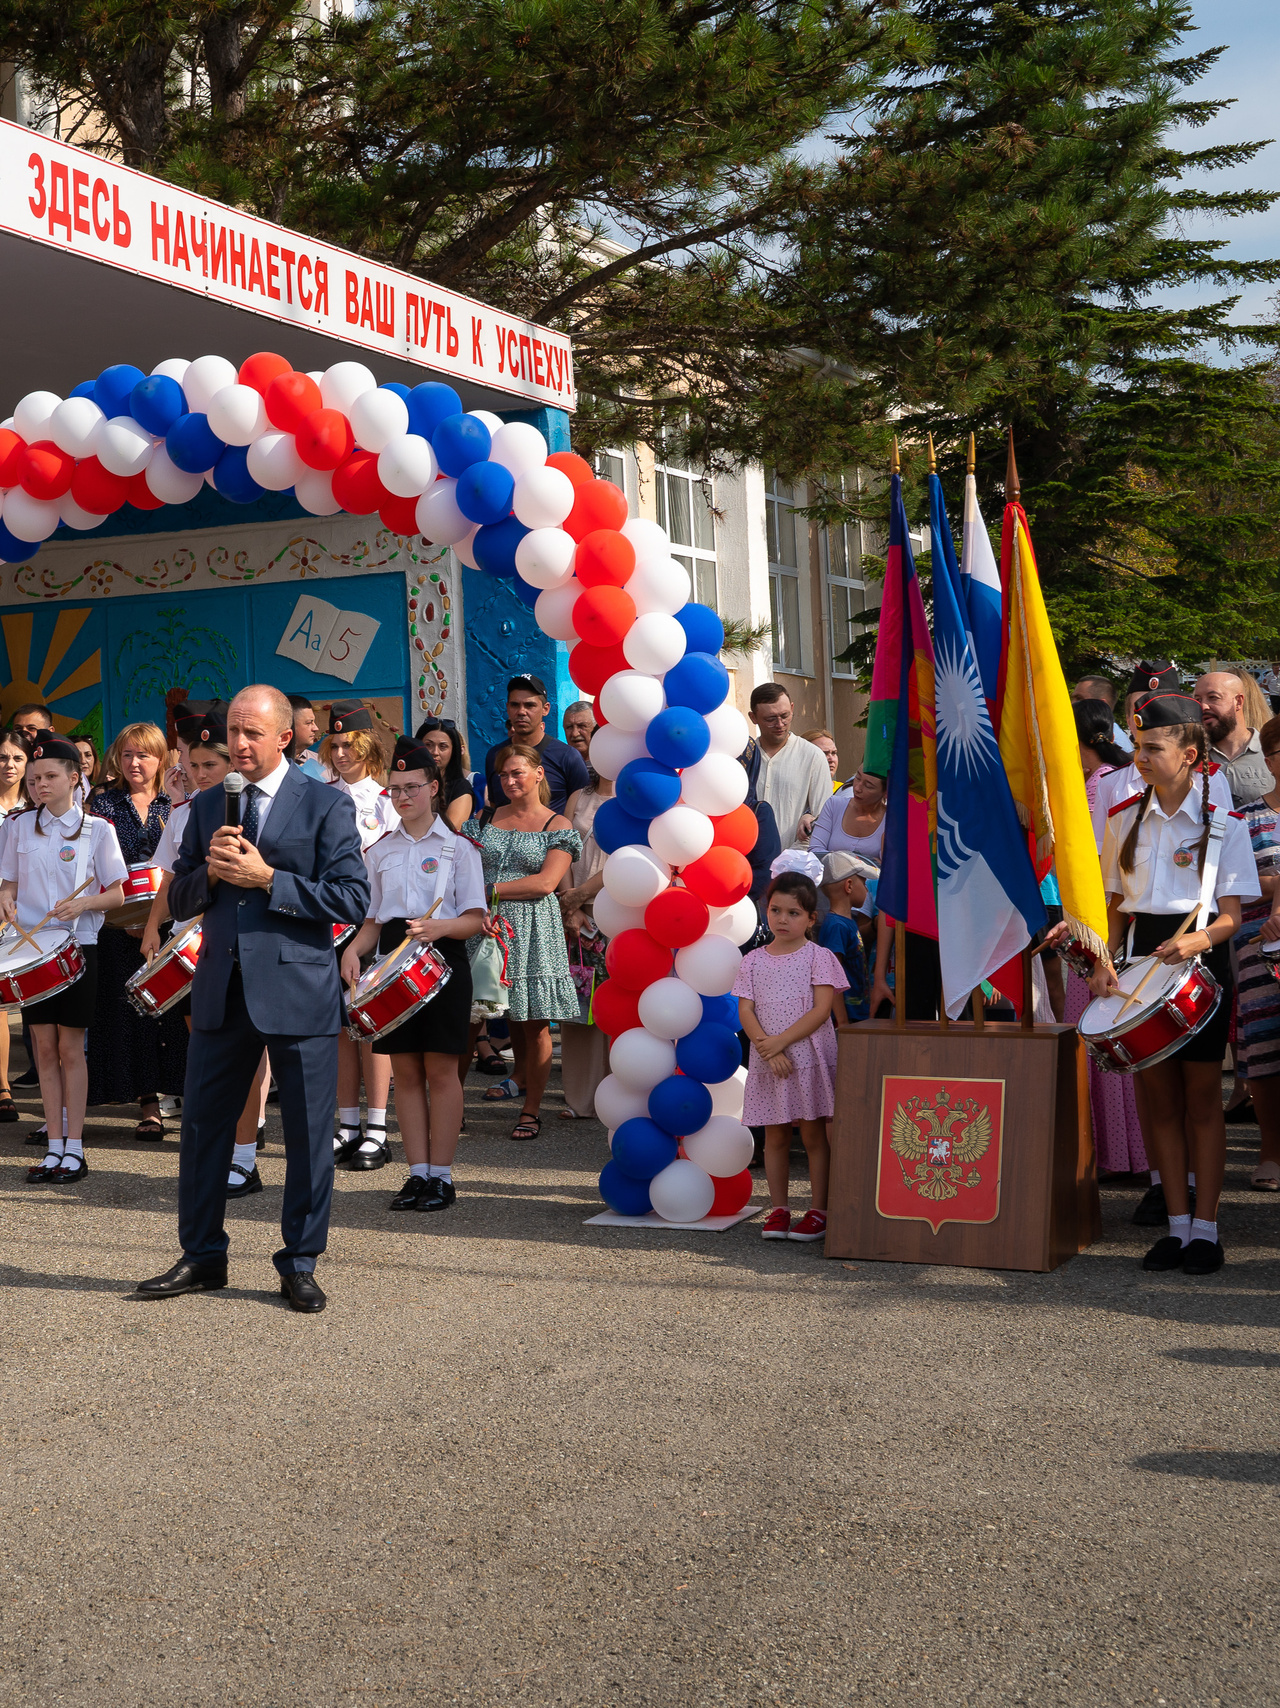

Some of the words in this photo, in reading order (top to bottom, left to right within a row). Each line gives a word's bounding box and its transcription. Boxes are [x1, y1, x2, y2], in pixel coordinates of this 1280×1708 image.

[28, 153, 132, 248] ЗДЕСЬ
[151, 201, 329, 316] НАЧИНАЕТСЯ
[345, 270, 395, 338] ВАШ
[406, 292, 459, 355] ПУТЬ
[472, 316, 484, 367] К
[497, 324, 572, 395] УСПЕХУ!
[329, 627, 362, 661] 5
